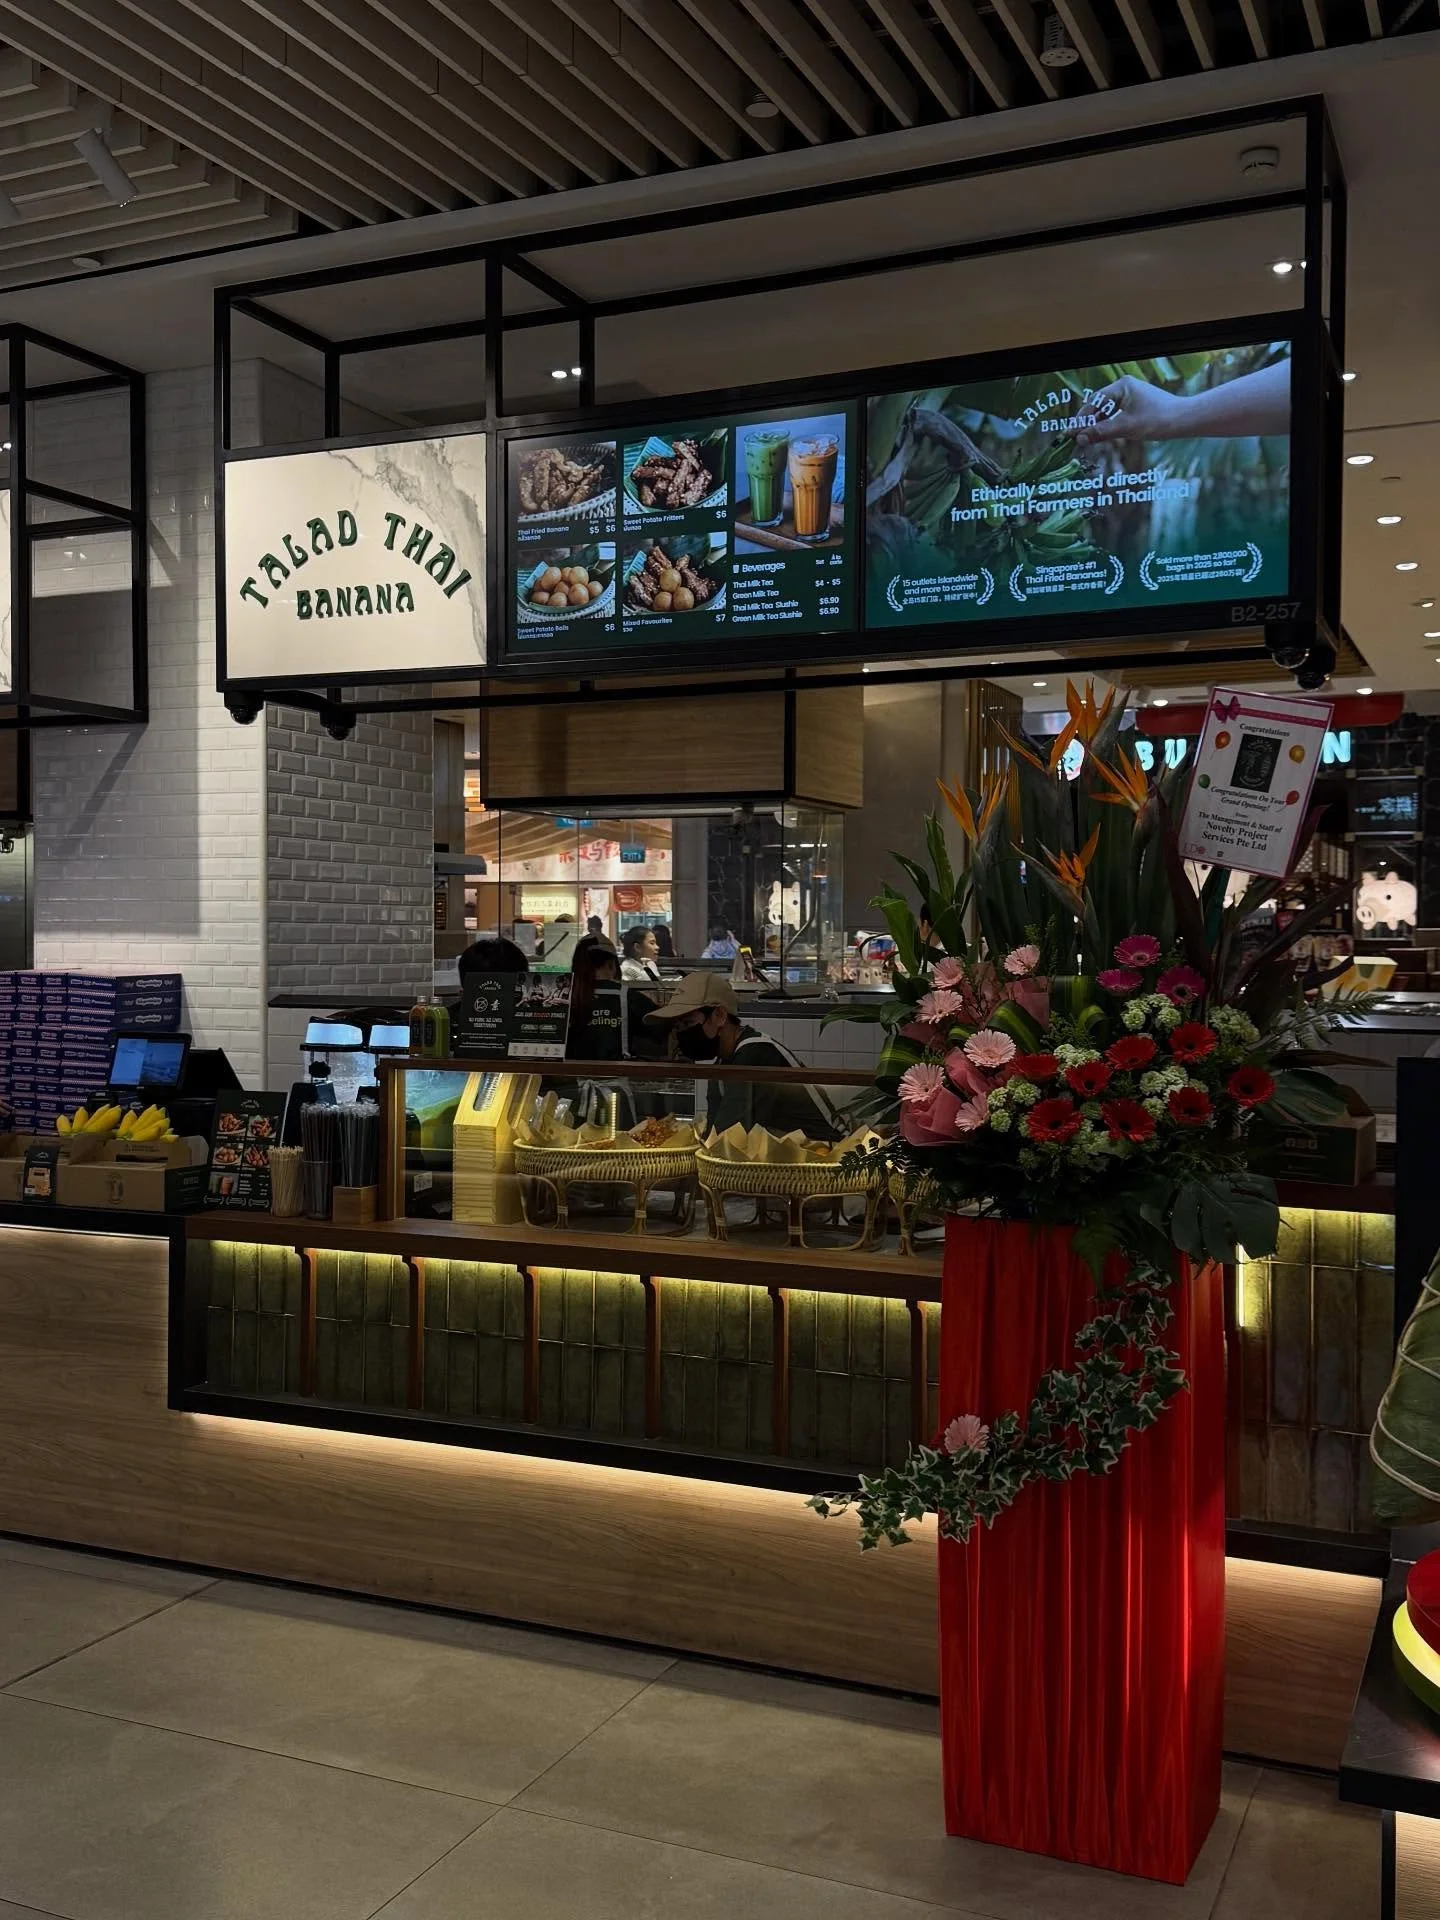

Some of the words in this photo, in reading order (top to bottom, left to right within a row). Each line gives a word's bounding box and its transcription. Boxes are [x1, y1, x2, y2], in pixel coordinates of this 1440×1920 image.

[1014, 388, 1071, 430] TALAD
[1083, 388, 1123, 420] THAI
[1041, 414, 1096, 432] BANANA
[971, 483, 1035, 503] Ethically
[1038, 475, 1103, 496] sourced
[1106, 467, 1169, 488] directly
[951, 507, 987, 522] from
[990, 500, 1025, 518] Thai
[1028, 494, 1093, 515] Farmers
[1098, 492, 1112, 506] in
[1115, 484, 1189, 505] Thailand
[715, 510, 727, 519] $6
[589, 525, 599, 534] $5
[605, 524, 616, 533] $6
[240, 509, 358, 609] TALAD
[384, 511, 472, 599] THAI
[742, 562, 786, 573] Beverages
[1036, 562, 1085, 575] Singapore's
[815, 579, 824, 587] $4
[832, 578, 841, 586] $5
[902, 579, 910, 587] 15
[911, 577, 937, 586] outlets
[937, 573, 978, 584] islandwide
[1025, 575, 1043, 584] Thai
[1044, 573, 1065, 582] Fried
[1066, 568, 1107, 580] Bananas!
[904, 586, 919, 595] and
[921, 586, 941, 594] more
[942, 584, 950, 592] to
[951, 581, 976, 591] come!
[296, 582, 415, 620] BANANA
[715, 613, 726, 622] $7
[732, 615, 752, 623] Green
[1231, 602, 1301, 623] B2-257
[1239, 723, 1290, 738] Congratulations
[1210, 786, 1258, 801] Congratulations
[1211, 813, 1250, 827] Management
[1258, 823, 1275, 832] Staff
[1206, 821, 1236, 836] Novelty
[1238, 827, 1268, 841] Project
[1201, 830, 1234, 845] Services
[1236, 837, 1249, 847] Pte
[1251, 841, 1267, 851] Ltd
